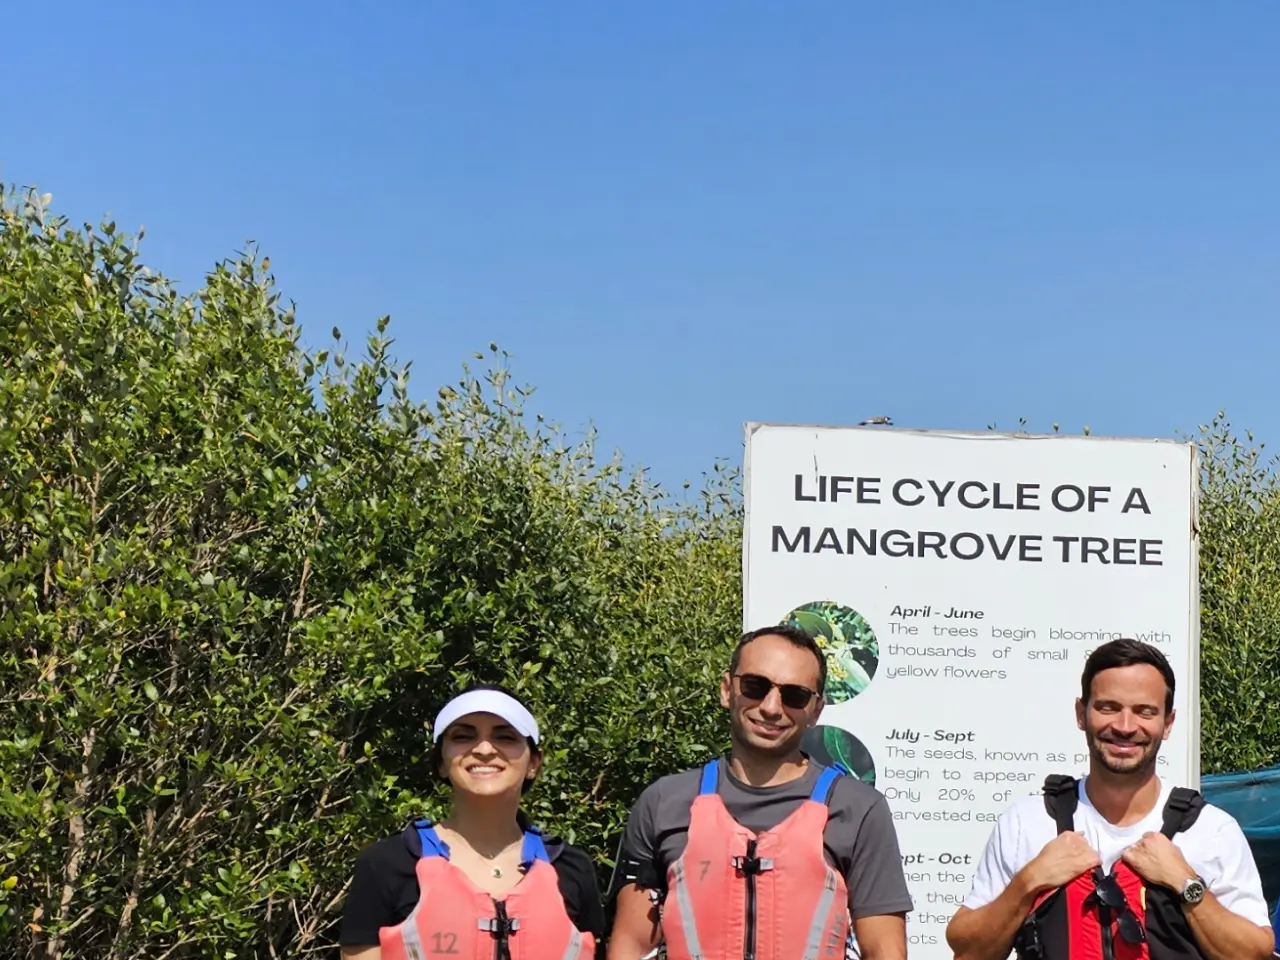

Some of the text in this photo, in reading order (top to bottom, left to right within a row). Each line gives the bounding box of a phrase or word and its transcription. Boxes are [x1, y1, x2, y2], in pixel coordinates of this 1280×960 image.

[794, 474, 1152, 515] LIFE CYCLE OF A
[771, 525, 1163, 566] MANGROVE TREE
[890, 605, 931, 619] April
[944, 607, 985, 620] June
[888, 623, 1171, 643] The trees begin blooming with
[888, 644, 1068, 660] thousands of small
[886, 666, 1007, 679] yellow flowers
[885, 729, 920, 743] July
[933, 730, 975, 744] Sept
[885, 746, 916, 759] The
[923, 748, 977, 761] seeds,
[985, 749, 1039, 762] known
[1046, 753, 1067, 763] as
[884, 767, 1035, 784] begin to appear
[884, 787, 1012, 803] Only 20% of
[892, 809, 971, 822] arvested
[938, 853, 971, 865] Oct
[700, 860, 711, 881] 7
[937, 871, 965, 883] the
[926, 891, 965, 906] they
[431, 932, 459, 954] 12
[906, 933, 938, 944] ots
